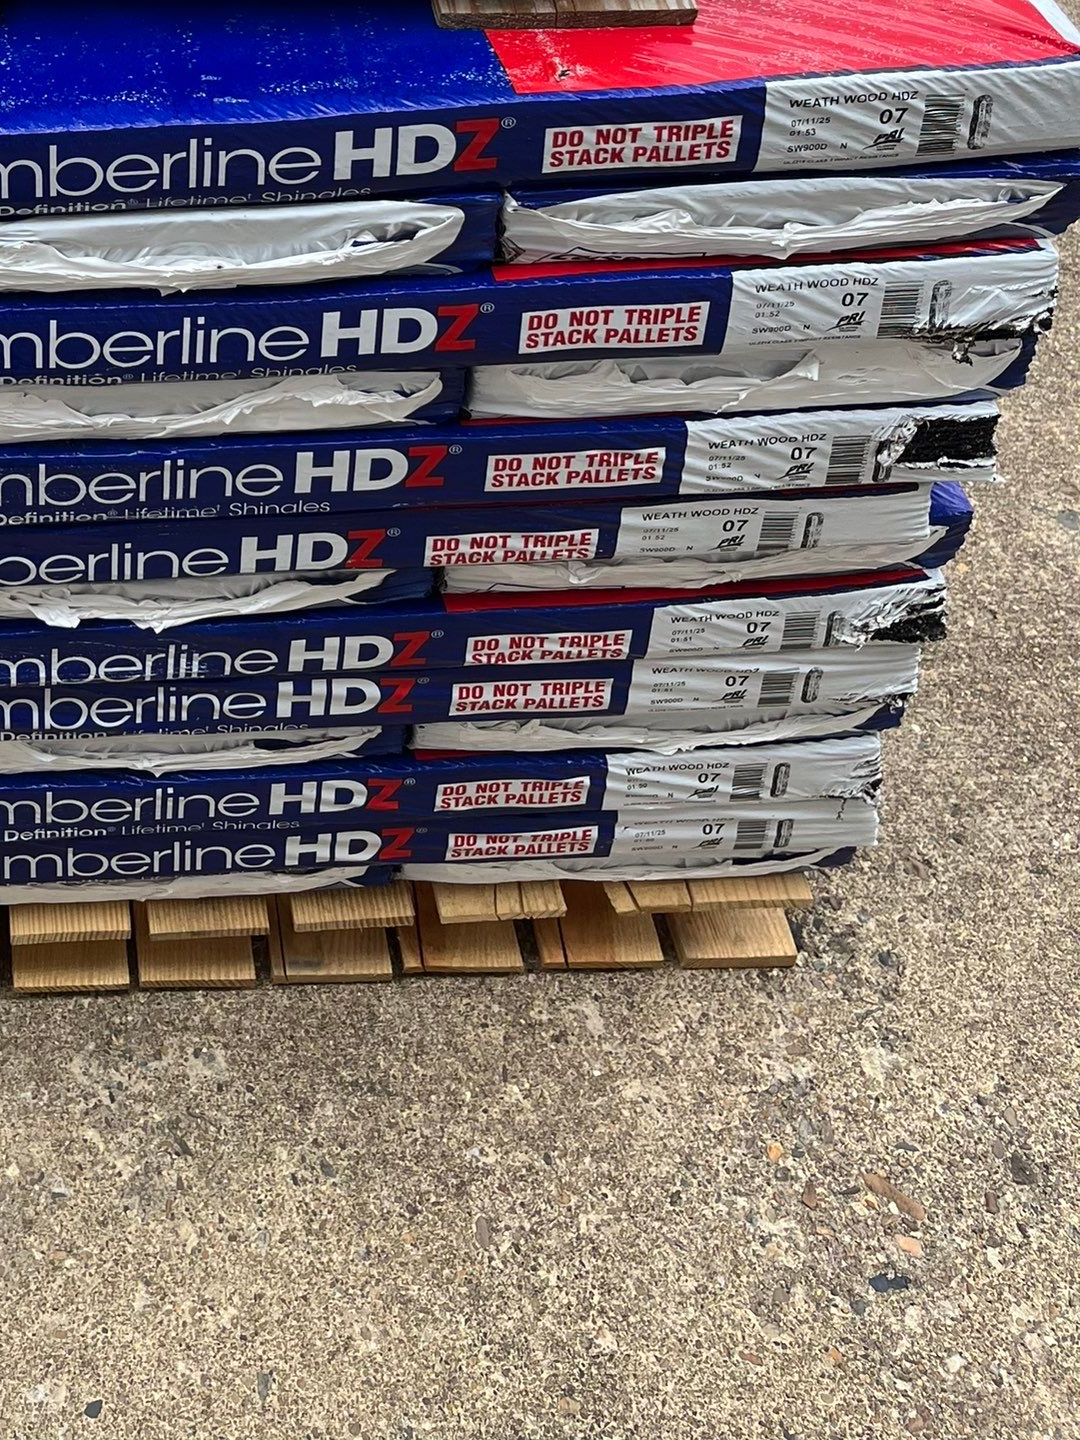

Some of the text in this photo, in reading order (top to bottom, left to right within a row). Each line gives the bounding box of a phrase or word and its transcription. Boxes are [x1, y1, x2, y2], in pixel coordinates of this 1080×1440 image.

[788, 90, 919, 109] WEATH WOOD HDZ
[790, 116, 831, 128] 07/11/25
[878, 108, 908, 125] 07
[551, 119, 735, 146] DO NOT TRIPLE
[789, 128, 817, 138] 01:53
[549, 140, 731, 167] STACK PALLETS
[840, 291, 869, 307] 07
[528, 306, 701, 330] DO NOT TRIPLE
[525, 325, 698, 349] STACK PALLETS
[790, 447, 818, 461] 07
[722, 520, 748, 533] 07
[746, 621, 771, 634] 07
[457, 679, 606, 699] DO NOT TRIPLE
[725, 675, 750, 688] 07
[455, 693, 605, 714] STACK PALLETS
[697, 772, 722, 785] 07
[441, 780, 585, 798] DO NOT TRIPLE
[440, 791, 582, 810] STACK PALLETS
[212, 819, 301, 832] Shingles
[702, 823, 725, 836] 07
